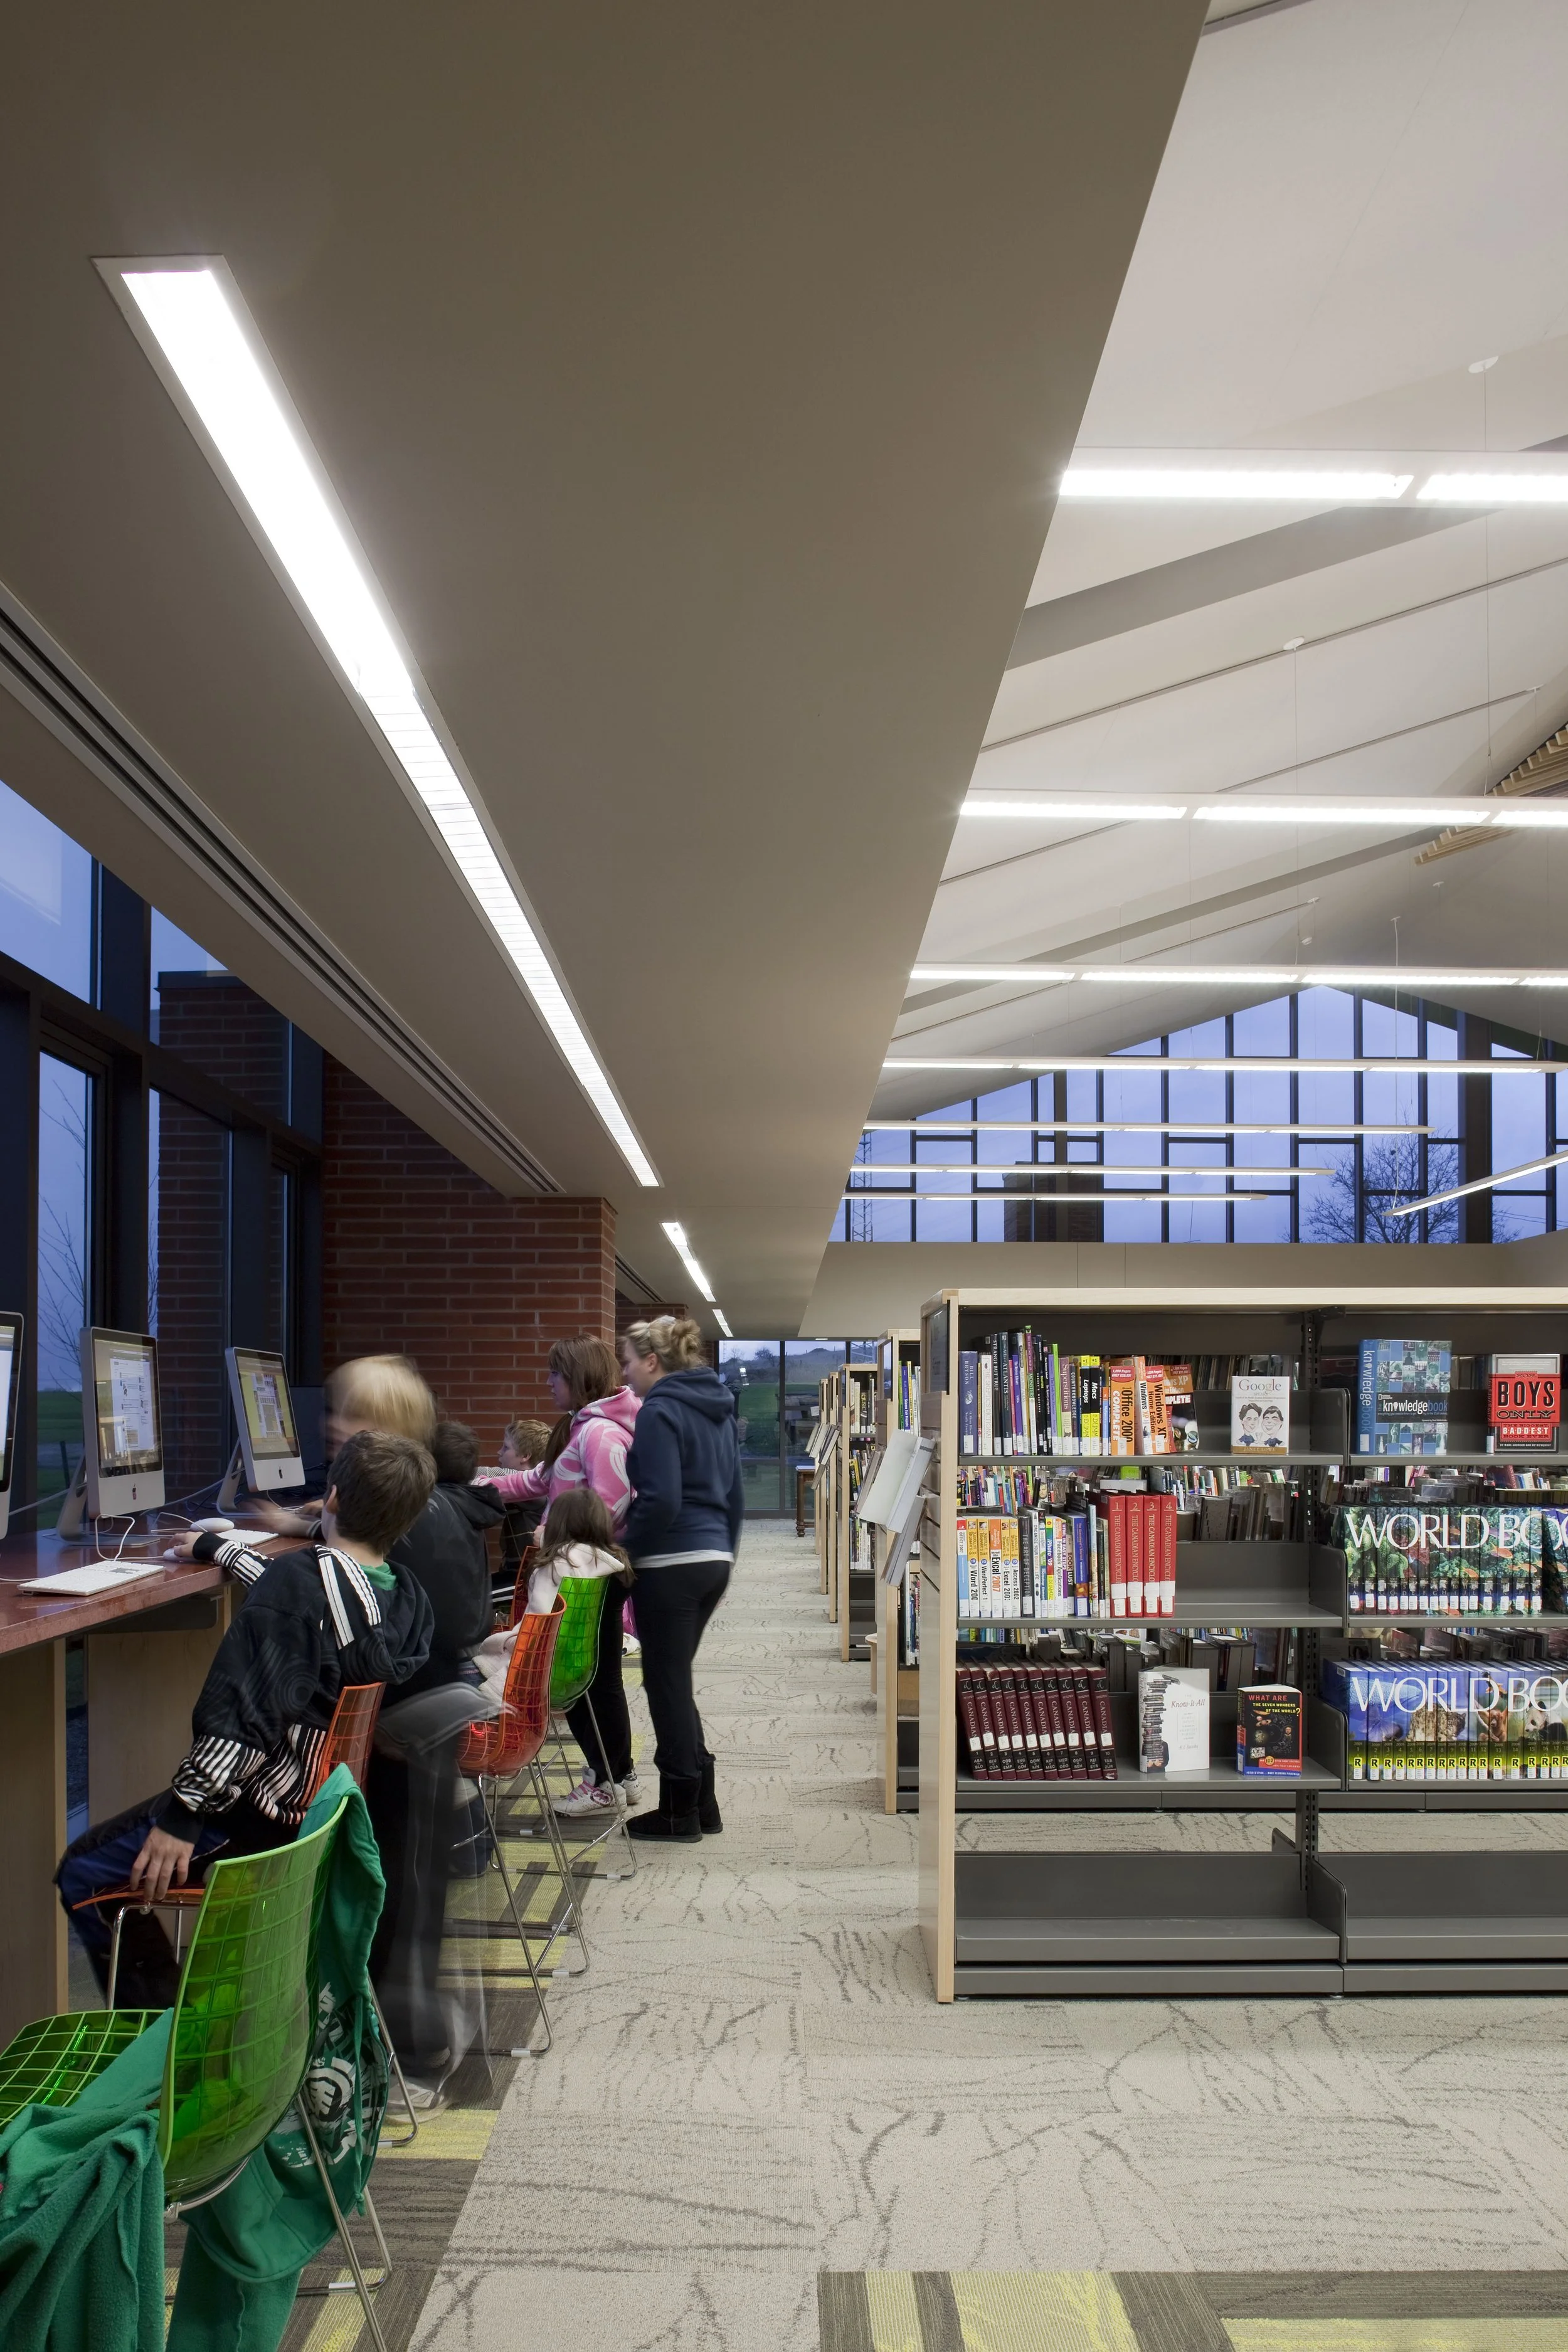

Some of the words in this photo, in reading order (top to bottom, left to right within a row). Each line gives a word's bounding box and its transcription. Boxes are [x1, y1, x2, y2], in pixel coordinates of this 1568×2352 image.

[1061, 1364, 1070, 1409] Superstitions
[1179, 1375, 1189, 1385] XP
[1239, 1379, 1281, 1393] Google
[1121, 1390, 1133, 1416] Office
[1140, 1382, 1148, 1409] Windows
[1154, 1384, 1164, 1424] Windows
[1165, 1394, 1190, 1405] MPLETE
[1498, 1381, 1555, 1407] BOYS
[1496, 1410, 1555, 1419] ONLY
[1121, 1420, 1133, 1442] 2000
[1345, 1514, 1489, 1549] WORLD
[1499, 1513, 1568, 1550] BO
[992, 1557, 1001, 1574] Excel
[992, 1576, 1000, 1592] 2007
[1352, 1677, 1499, 1713] WORLD
[1508, 1676, 1568, 1712] BO
[967, 1702, 977, 1737] CANADIA
[996, 1702, 1004, 1735] CANADIA
[1010, 1702, 1019, 1734] CANADIA
[1024, 1702, 1032, 1734] CANADIA
[1038, 1702, 1047, 1734] CANADIA
[1066, 1701, 1075, 1734] CANADIA
[1372, 1759, 1377, 1767] R
[1495, 1759, 1500, 1767] R
